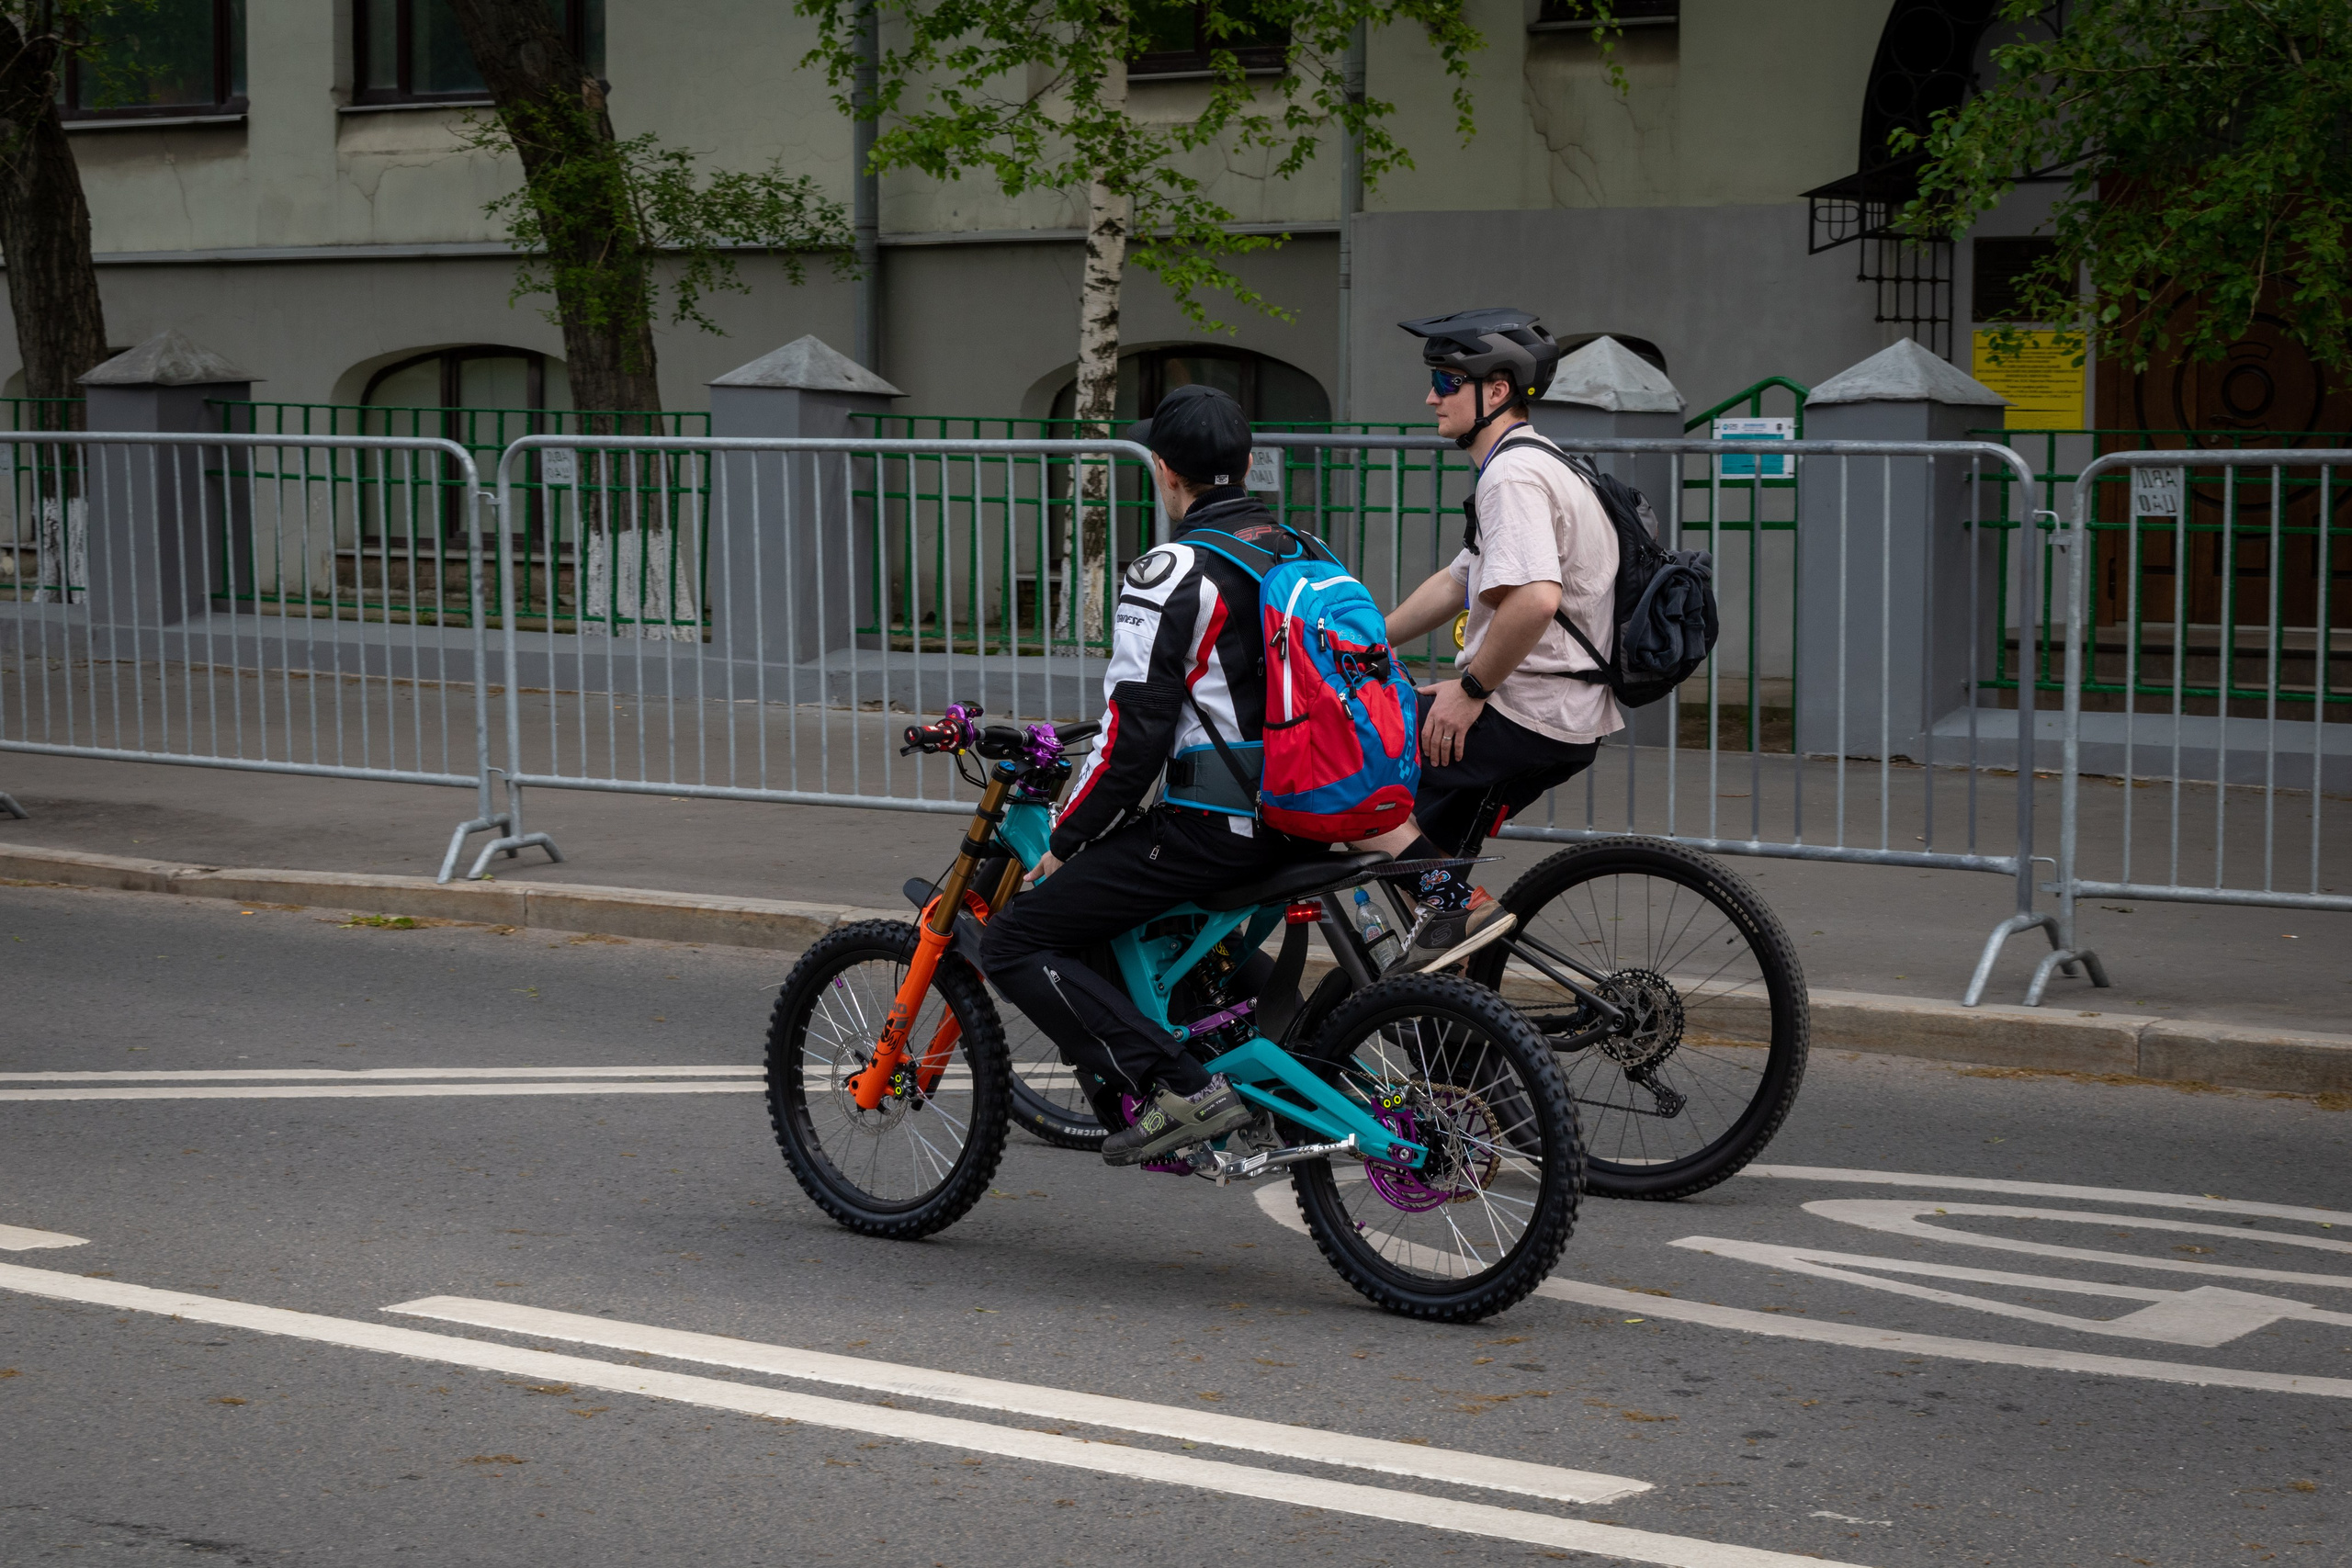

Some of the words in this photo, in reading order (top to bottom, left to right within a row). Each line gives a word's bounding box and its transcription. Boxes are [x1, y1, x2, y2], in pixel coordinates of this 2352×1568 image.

[1404, 701, 1415, 761] CUBE
[1706, 880, 1759, 933] PURGATORY
[1063, 1126, 1110, 1137] BUTCHER
